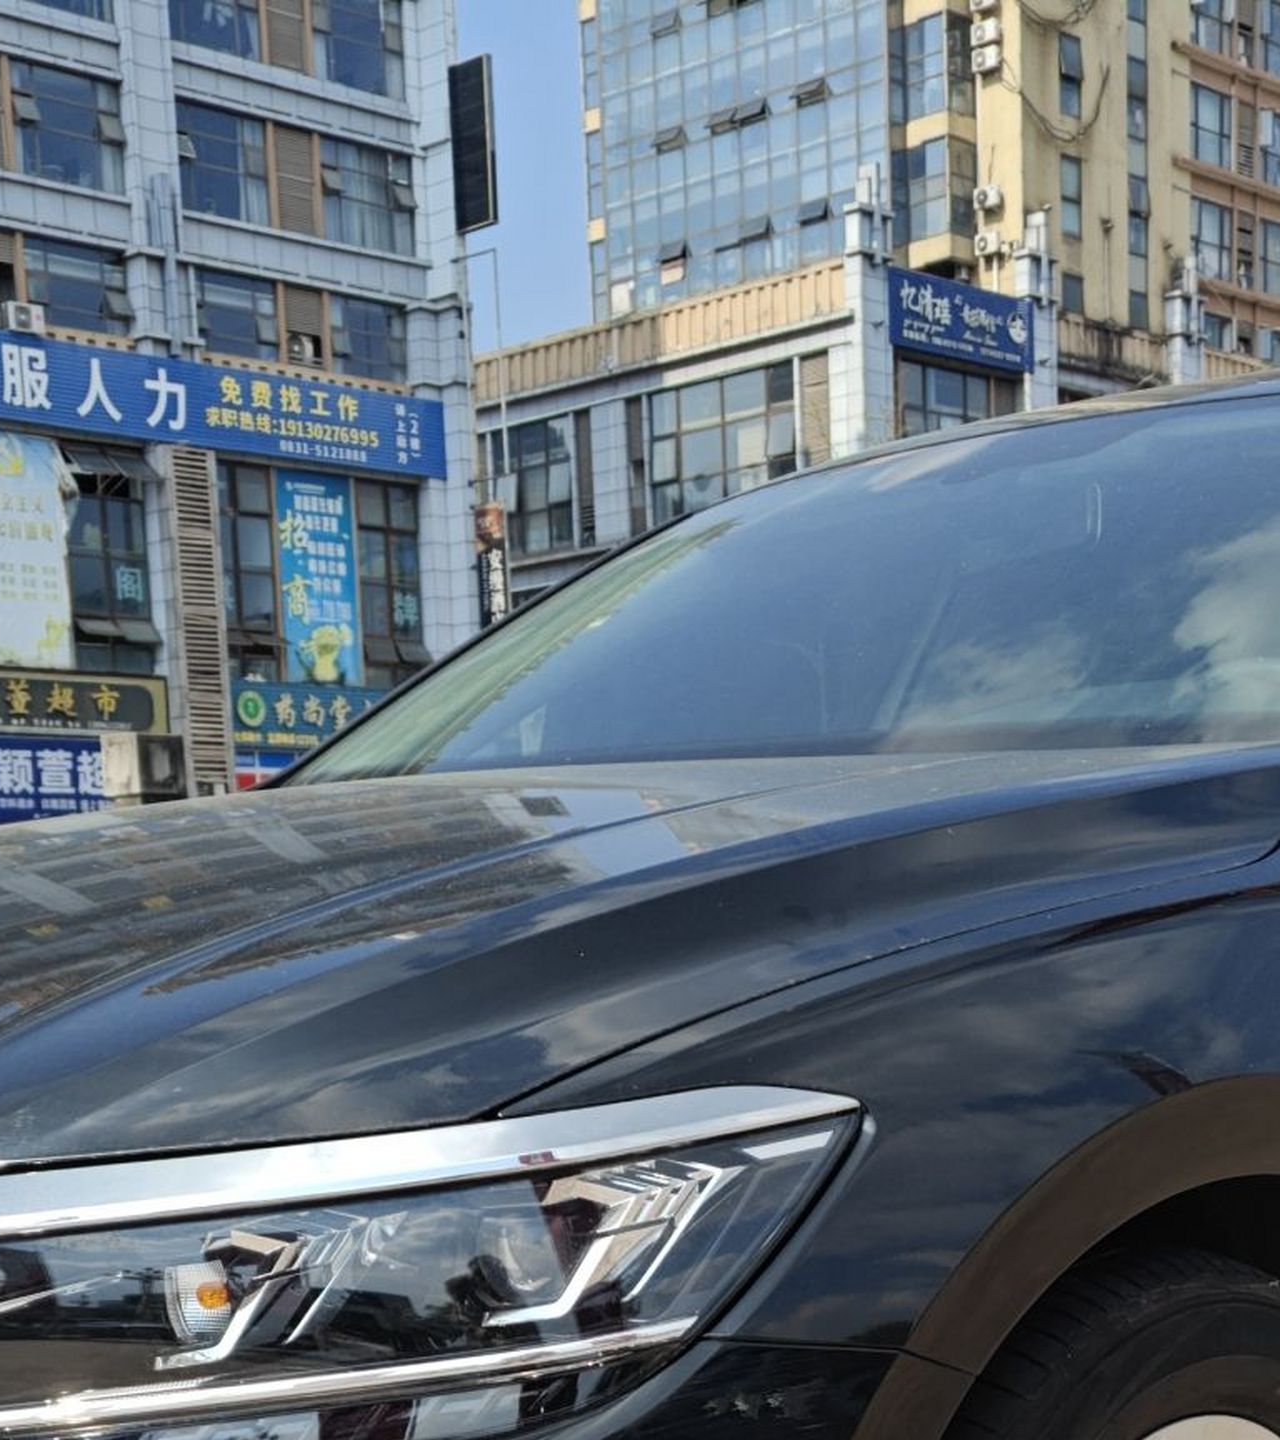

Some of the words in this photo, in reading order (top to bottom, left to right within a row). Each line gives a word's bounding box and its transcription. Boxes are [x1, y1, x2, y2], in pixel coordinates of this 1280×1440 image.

[220, 375, 360, 422] 免费找工作
